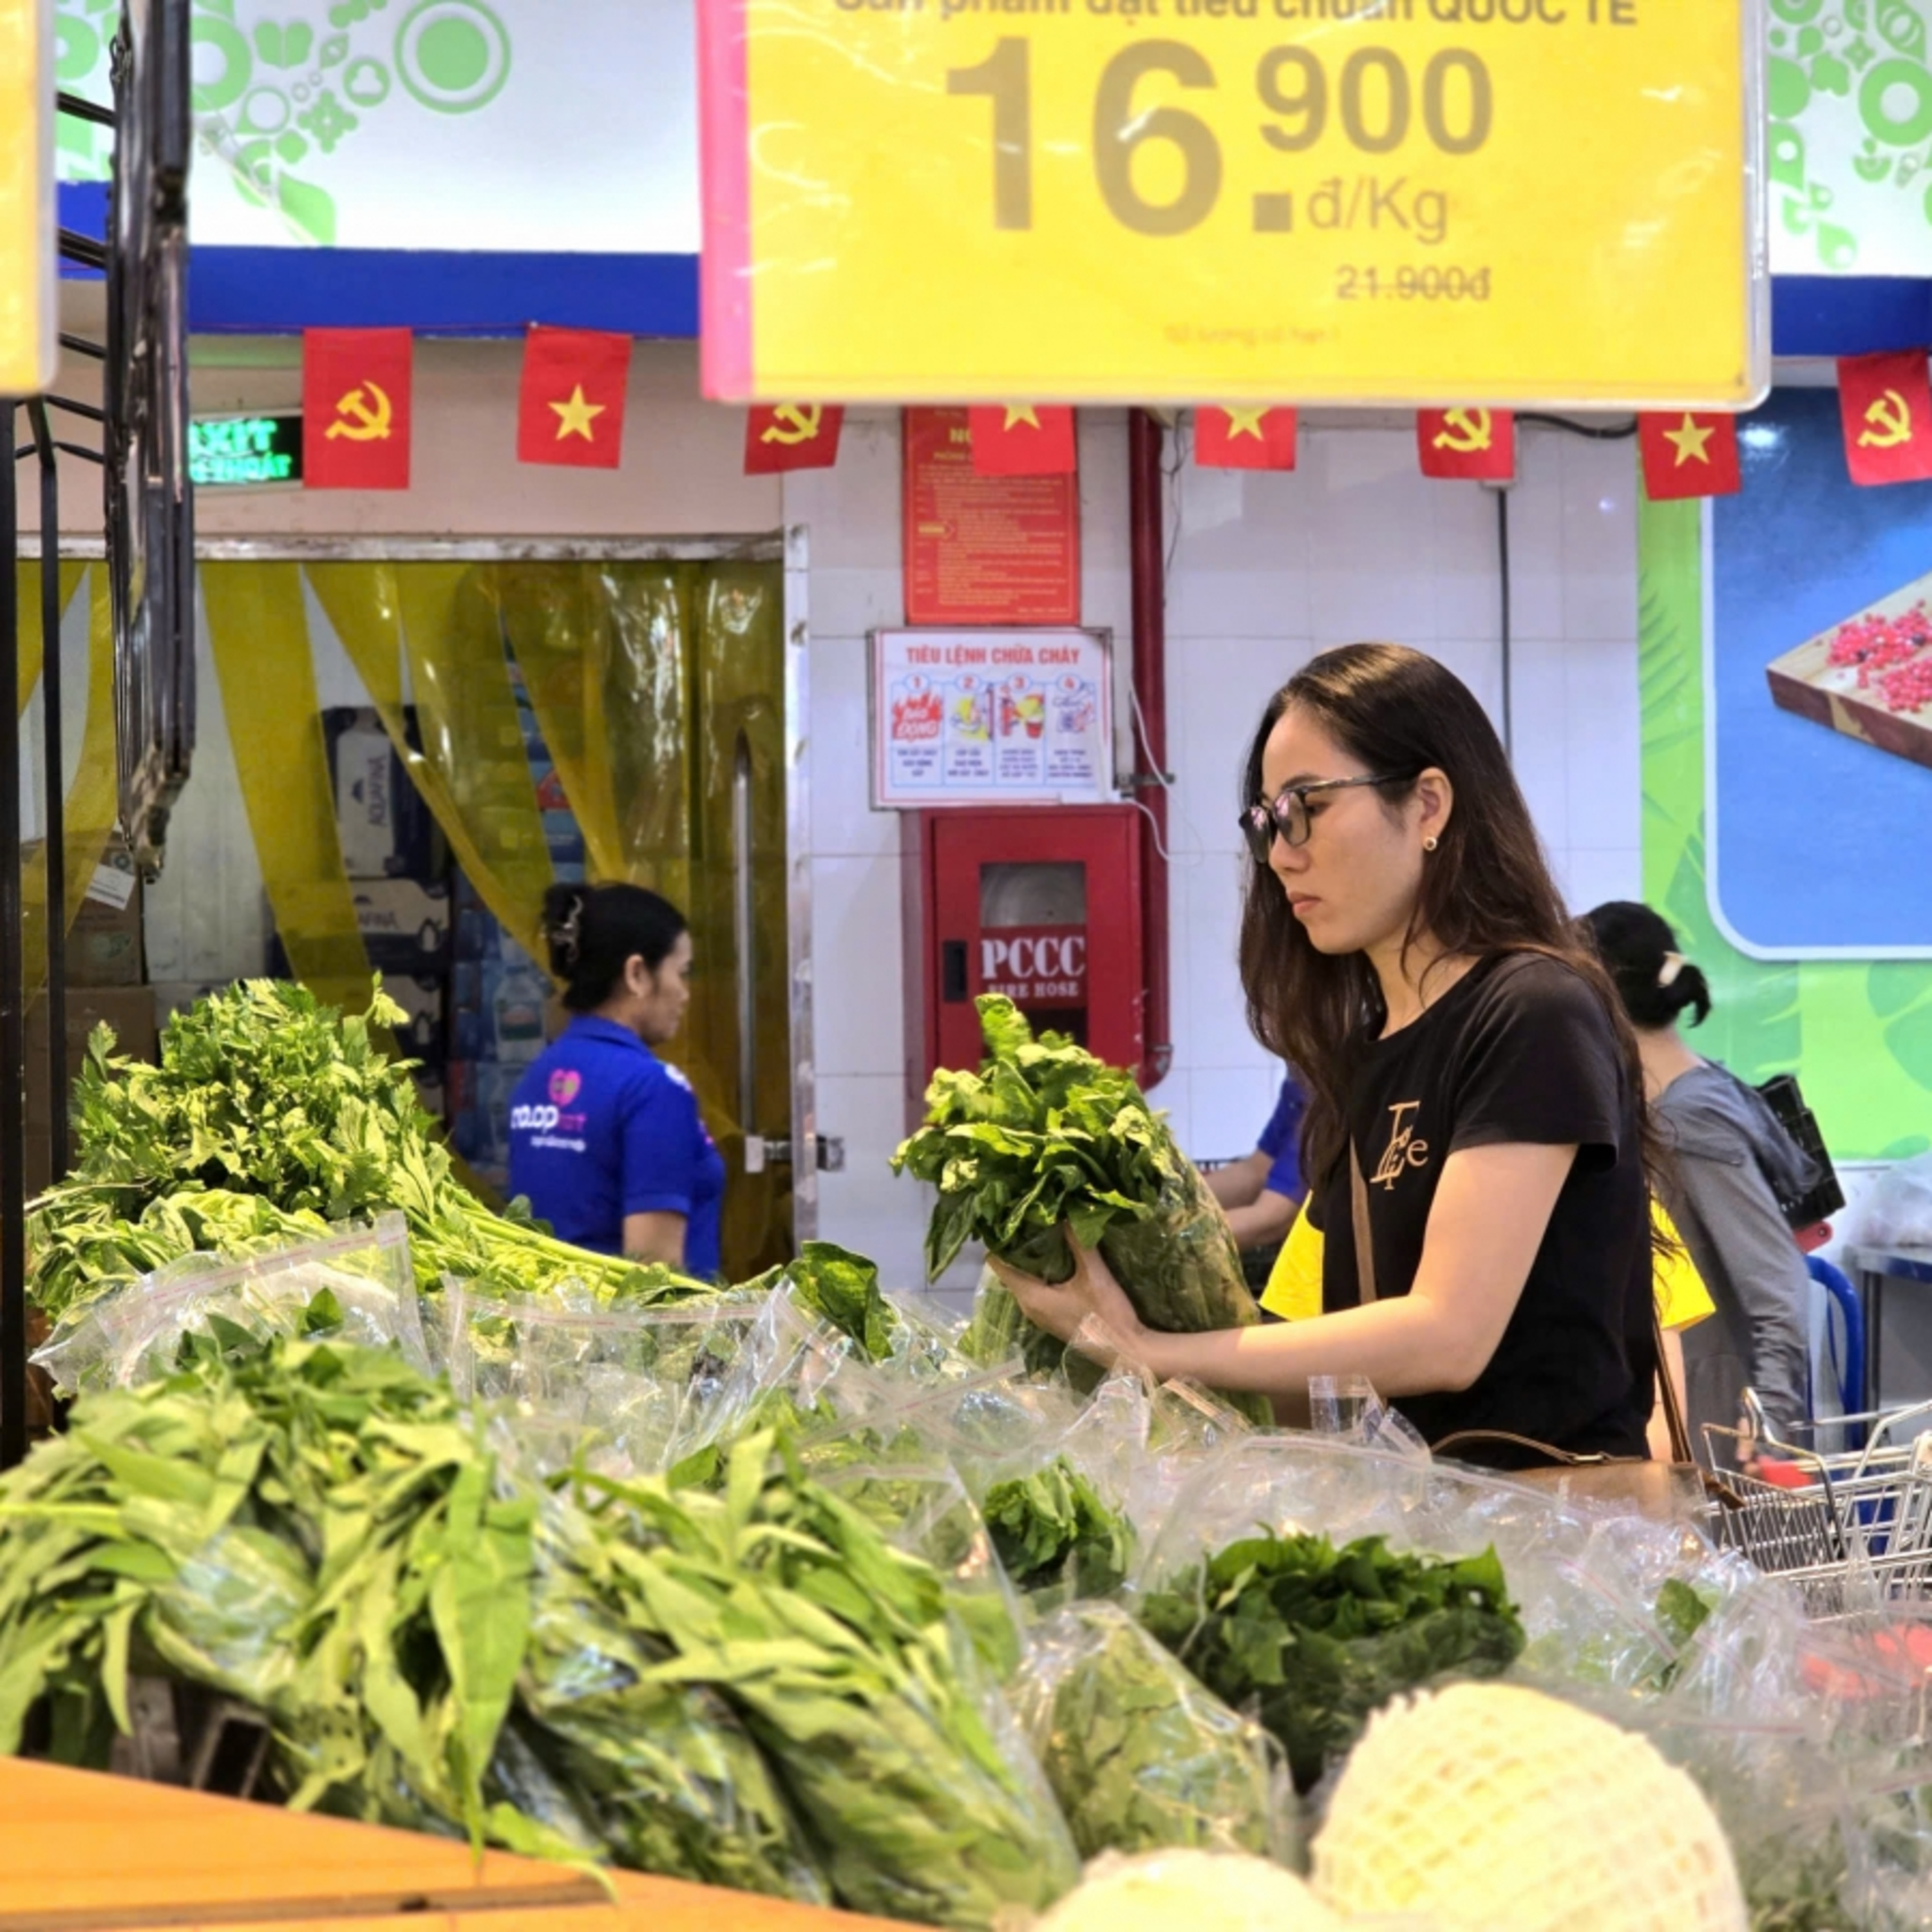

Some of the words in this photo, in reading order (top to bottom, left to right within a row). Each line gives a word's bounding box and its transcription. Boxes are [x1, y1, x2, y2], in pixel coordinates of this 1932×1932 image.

[1307, 176, 1447, 245] đ/Kg
[905, 644, 940, 664] TIÊU
[945, 644, 987, 667] LỆNH
[991, 643, 1034, 665] CHỮA
[1038, 643, 1080, 665] CHÁY
[963, 676, 973, 689] 2
[1016, 676, 1025, 690] 3
[1065, 677, 1075, 690] 4
[981, 936, 1085, 979] PCCC
[987, 983, 1029, 998] FIRE
[1034, 981, 1078, 997] HOSE
